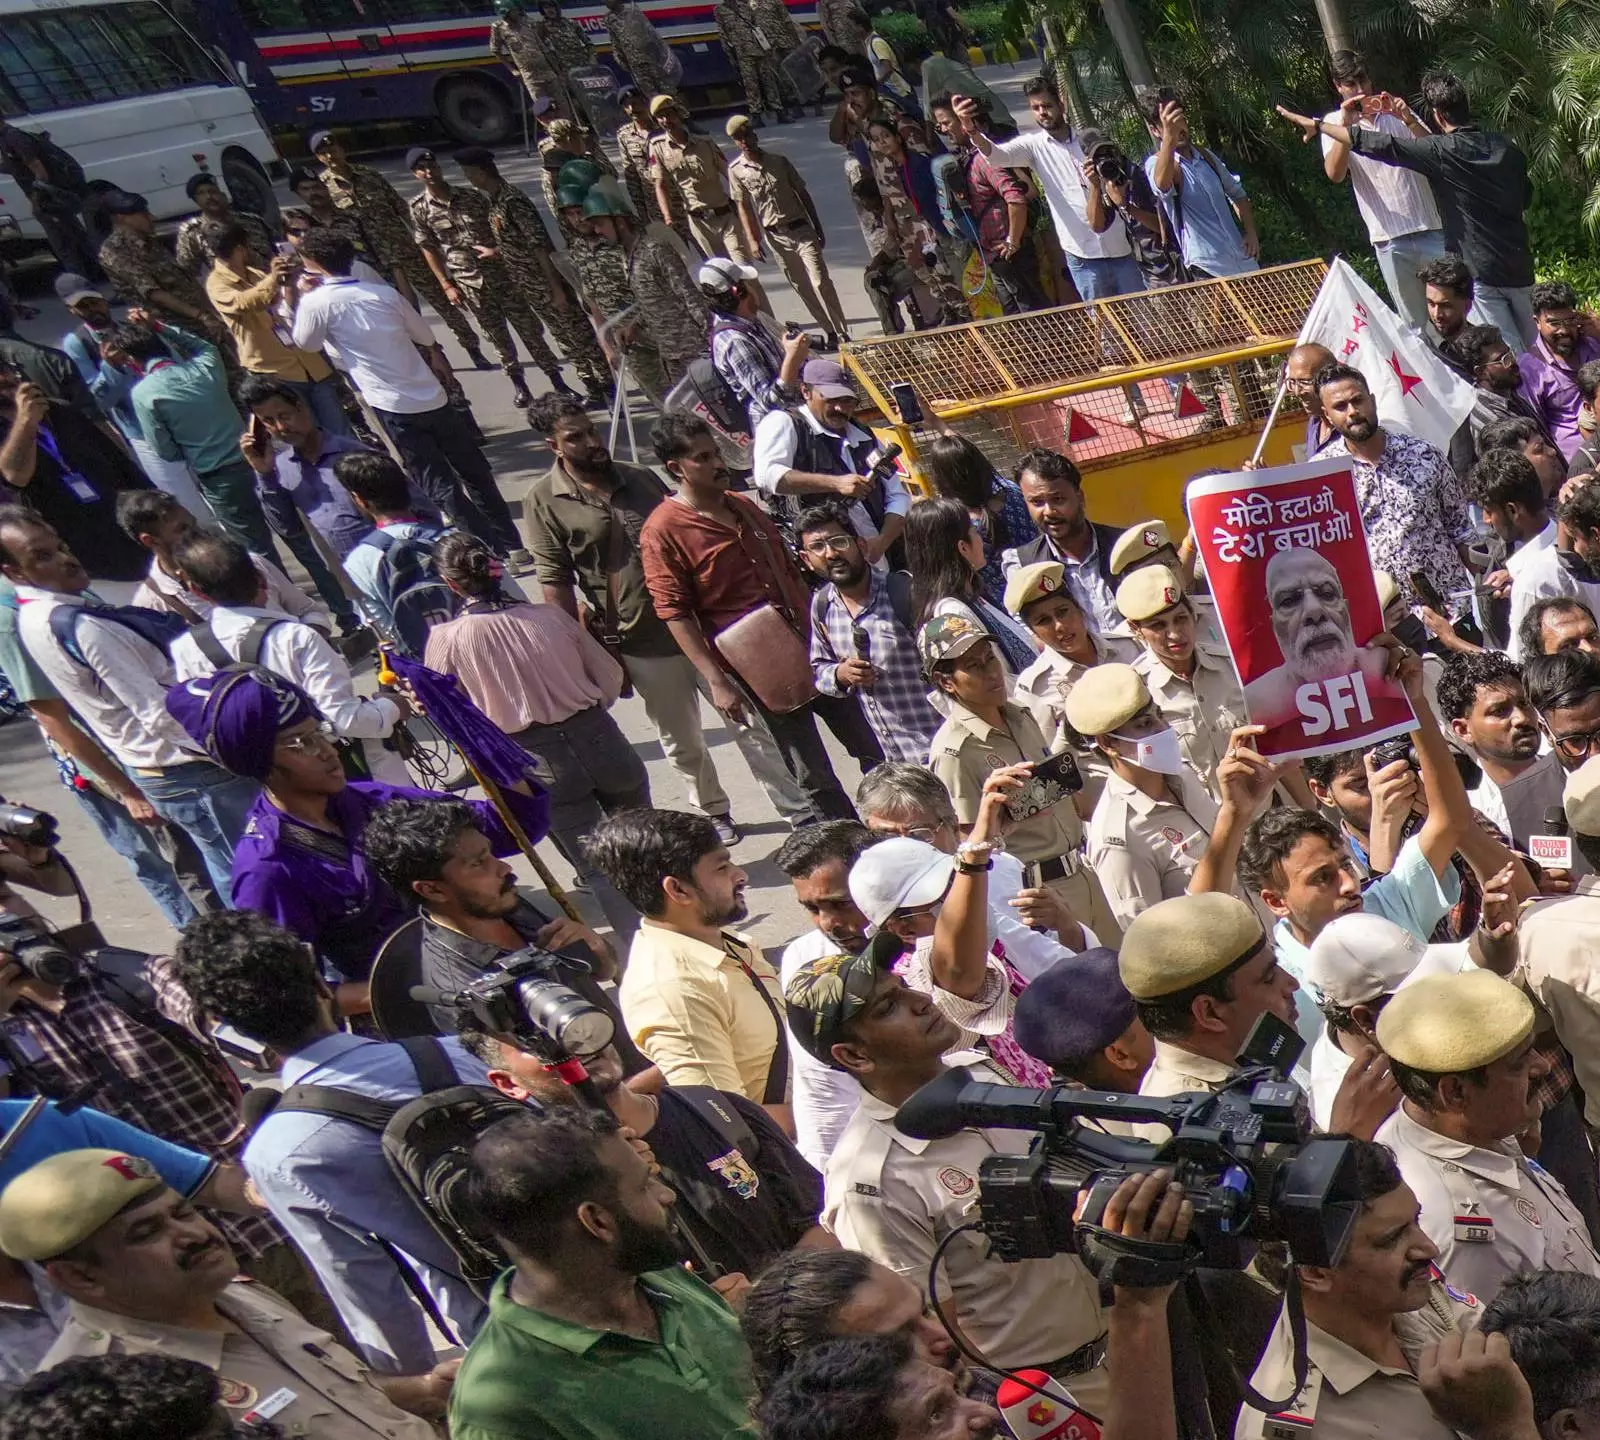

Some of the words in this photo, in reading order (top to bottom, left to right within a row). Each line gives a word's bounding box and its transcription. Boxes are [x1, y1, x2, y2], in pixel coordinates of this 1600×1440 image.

[310, 97, 336, 113] S7
[1340, 302, 1369, 362] DYF
[1222, 491, 1275, 529] मोदी
[1278, 485, 1335, 524] हटाओ
[1213, 527, 1266, 564] देश
[1269, 512, 1354, 553] बचाओ!
[1296, 671, 1374, 737] SFI
[1533, 848, 1567, 857] VOICE
